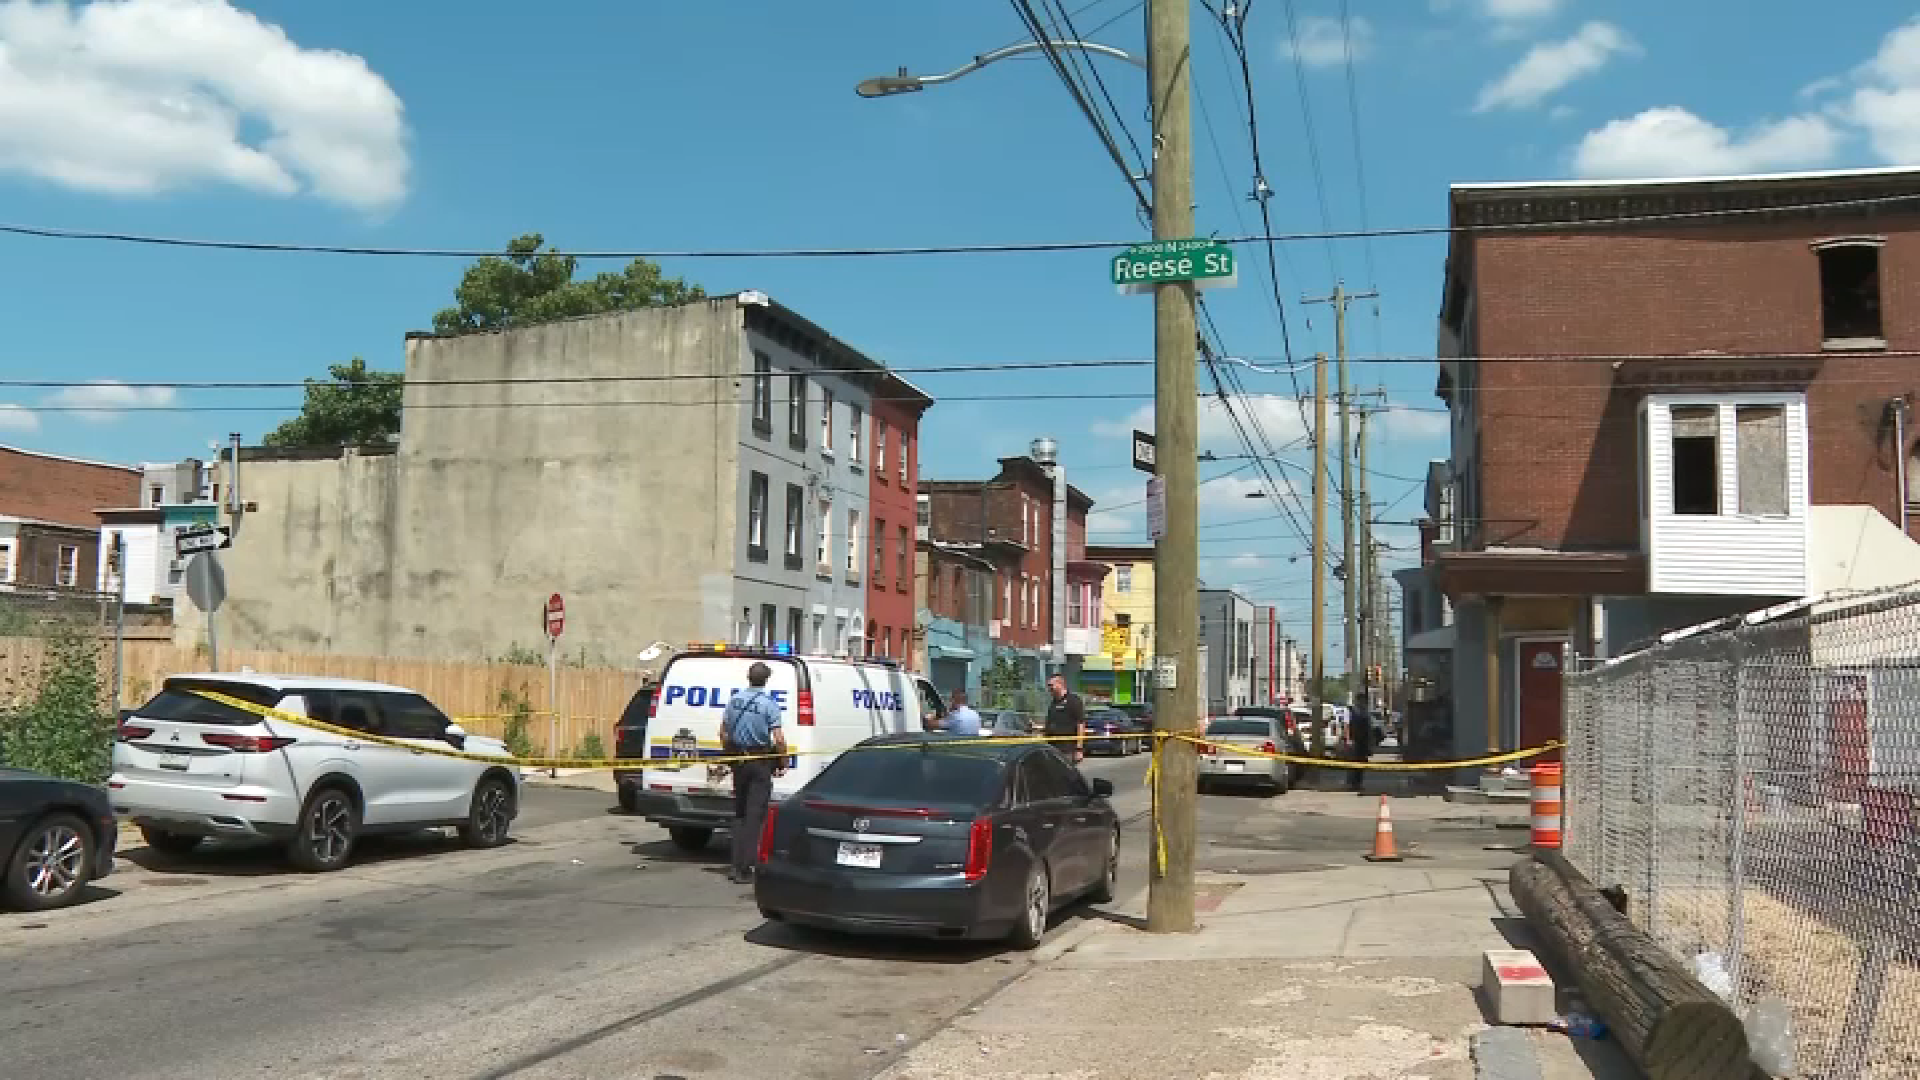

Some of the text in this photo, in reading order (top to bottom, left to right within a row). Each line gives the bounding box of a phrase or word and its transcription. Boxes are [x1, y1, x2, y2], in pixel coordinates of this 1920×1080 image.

[1165, 241, 1177, 253] N
[1115, 253, 1230, 281] Reese St
[665, 685, 788, 711] POLE
[853, 689, 902, 711] POLICE
